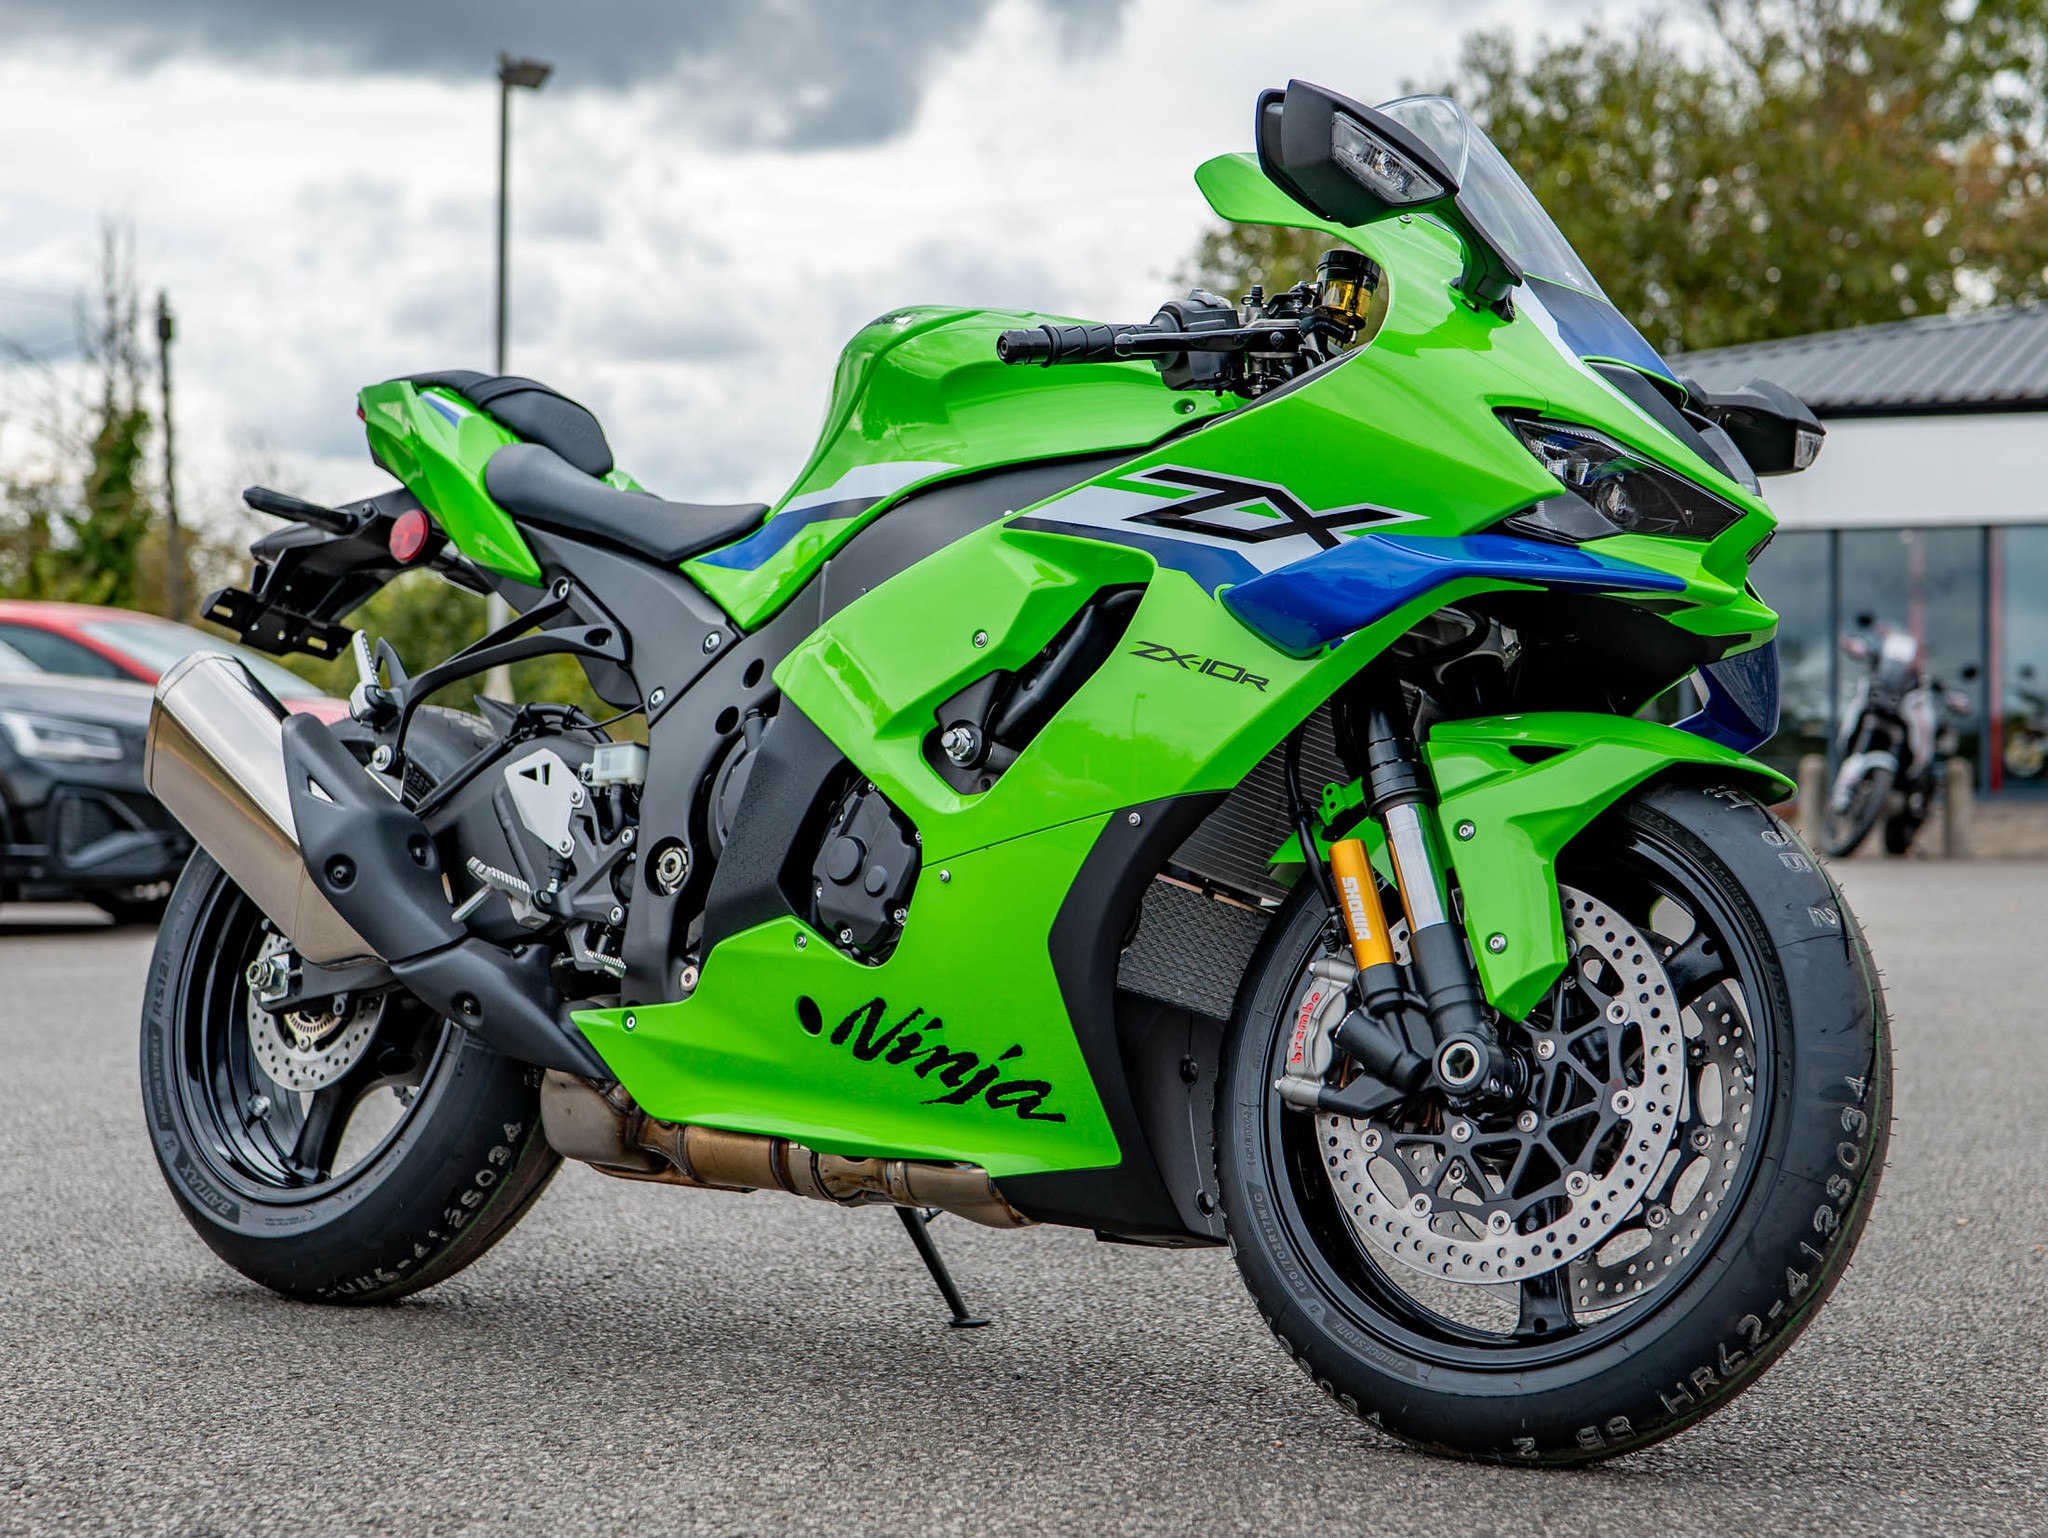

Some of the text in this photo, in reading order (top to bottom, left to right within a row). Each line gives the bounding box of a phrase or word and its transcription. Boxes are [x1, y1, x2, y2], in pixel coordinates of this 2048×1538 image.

[1129, 640, 1270, 692] ZX-10R
[1341, 876, 1371, 941] SHOWA
[1290, 992, 1320, 1064] brembo
[830, 997, 1067, 1123] Ninja
[180, 1158, 231, 1216] BATTLAX
[1332, 1320, 1409, 1371] BRIDGESTONE
